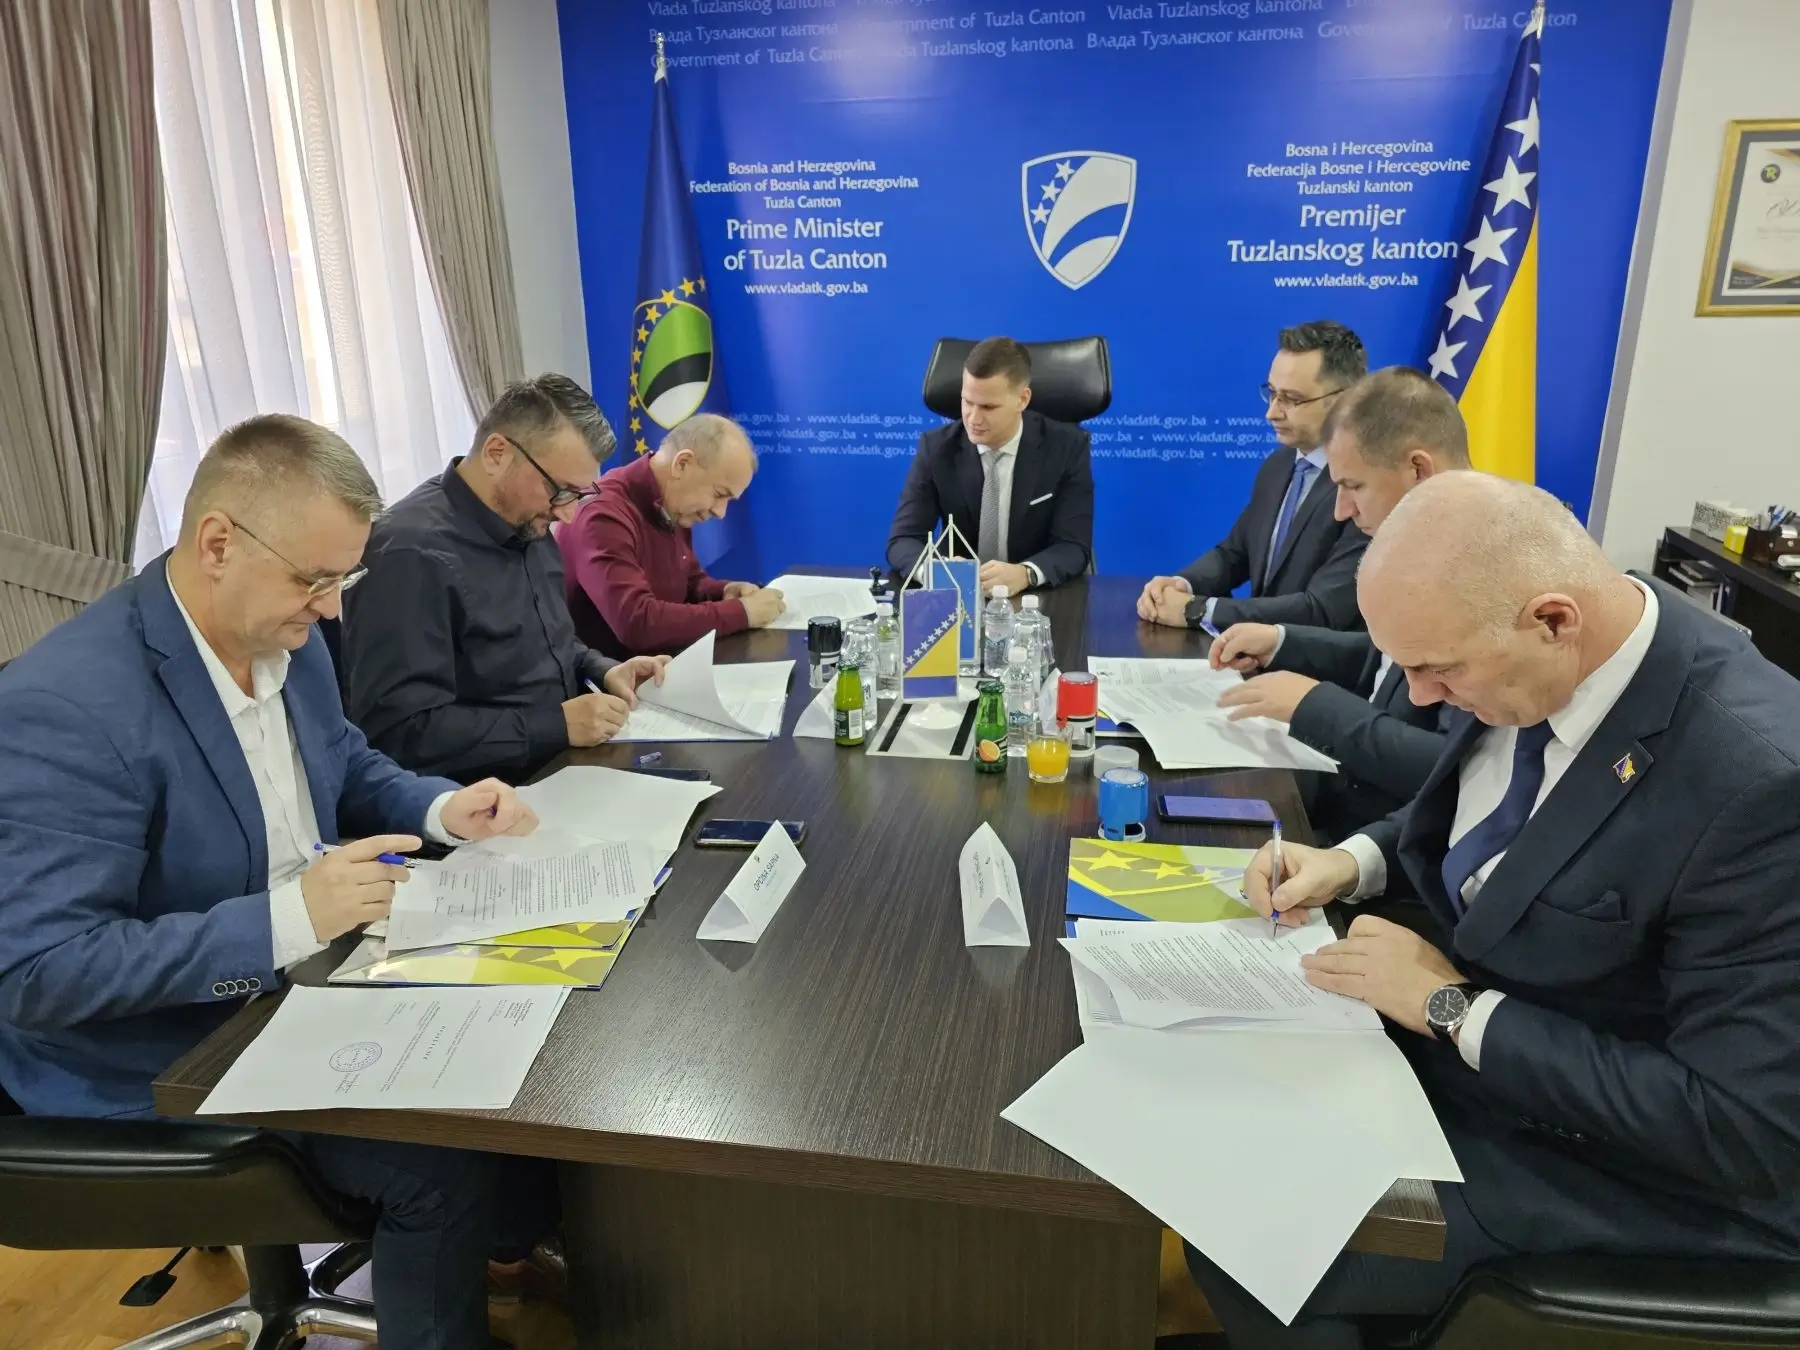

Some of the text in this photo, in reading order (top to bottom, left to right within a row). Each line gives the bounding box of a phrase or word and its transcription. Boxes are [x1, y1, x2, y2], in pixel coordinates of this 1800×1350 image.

[648, 2, 688, 16] Vlada
[692, 0, 772, 15] Tuzlanskog
[1106, 0, 1325, 20] Vlada Tuzlanskog kantona
[959, 12, 976, 29] of
[984, 10, 1025, 27] Tuzla
[1028, 8, 1086, 25] Canton
[1463, 12, 1508, 31] Tuzla
[1512, 11, 1578, 28] Cton
[922, 39, 1007, 58] Tuzlanskog
[1011, 37, 1074, 53] kantona
[1087, 32, 1137, 50] Влада
[1140, 30, 1233, 51] Тузланског
[1237, 27, 1304, 42] кантона
[744, 49, 761, 65] of
[767, 47, 805, 63] Tuzla
[1285, 139, 1433, 157] Bosna i Hercegovina
[728, 159, 876, 174] Bosnia and Herzegovina
[1247, 157, 1471, 178] Federacija Bosne i Hercegovine
[689, 177, 919, 193] Federation of Bosnia and Herzegovina
[1297, 179, 1413, 195] Tuzlanski kanton
[763, 196, 841, 209] Tuzla Canton
[1300, 203, 1406, 232] Premijer
[726, 217, 883, 240] Prime Minister
[723, 248, 887, 271] of Tuzla Canton
[1227, 236, 1458, 267] Tuzlanskog kanton
[744, 280, 869, 296] www.vladatk.gov.ba
[1274, 272, 1419, 289] www.vladatk.gov.ba
[807, 412, 923, 428] www.vladatk.gov.ba
[1152, 431, 1276, 446] www.vladatk.gov.b
[808, 443, 918, 459] www.vladatk.gov.b
[1091, 447, 1205, 462] ww.vladatk.gov.ba
